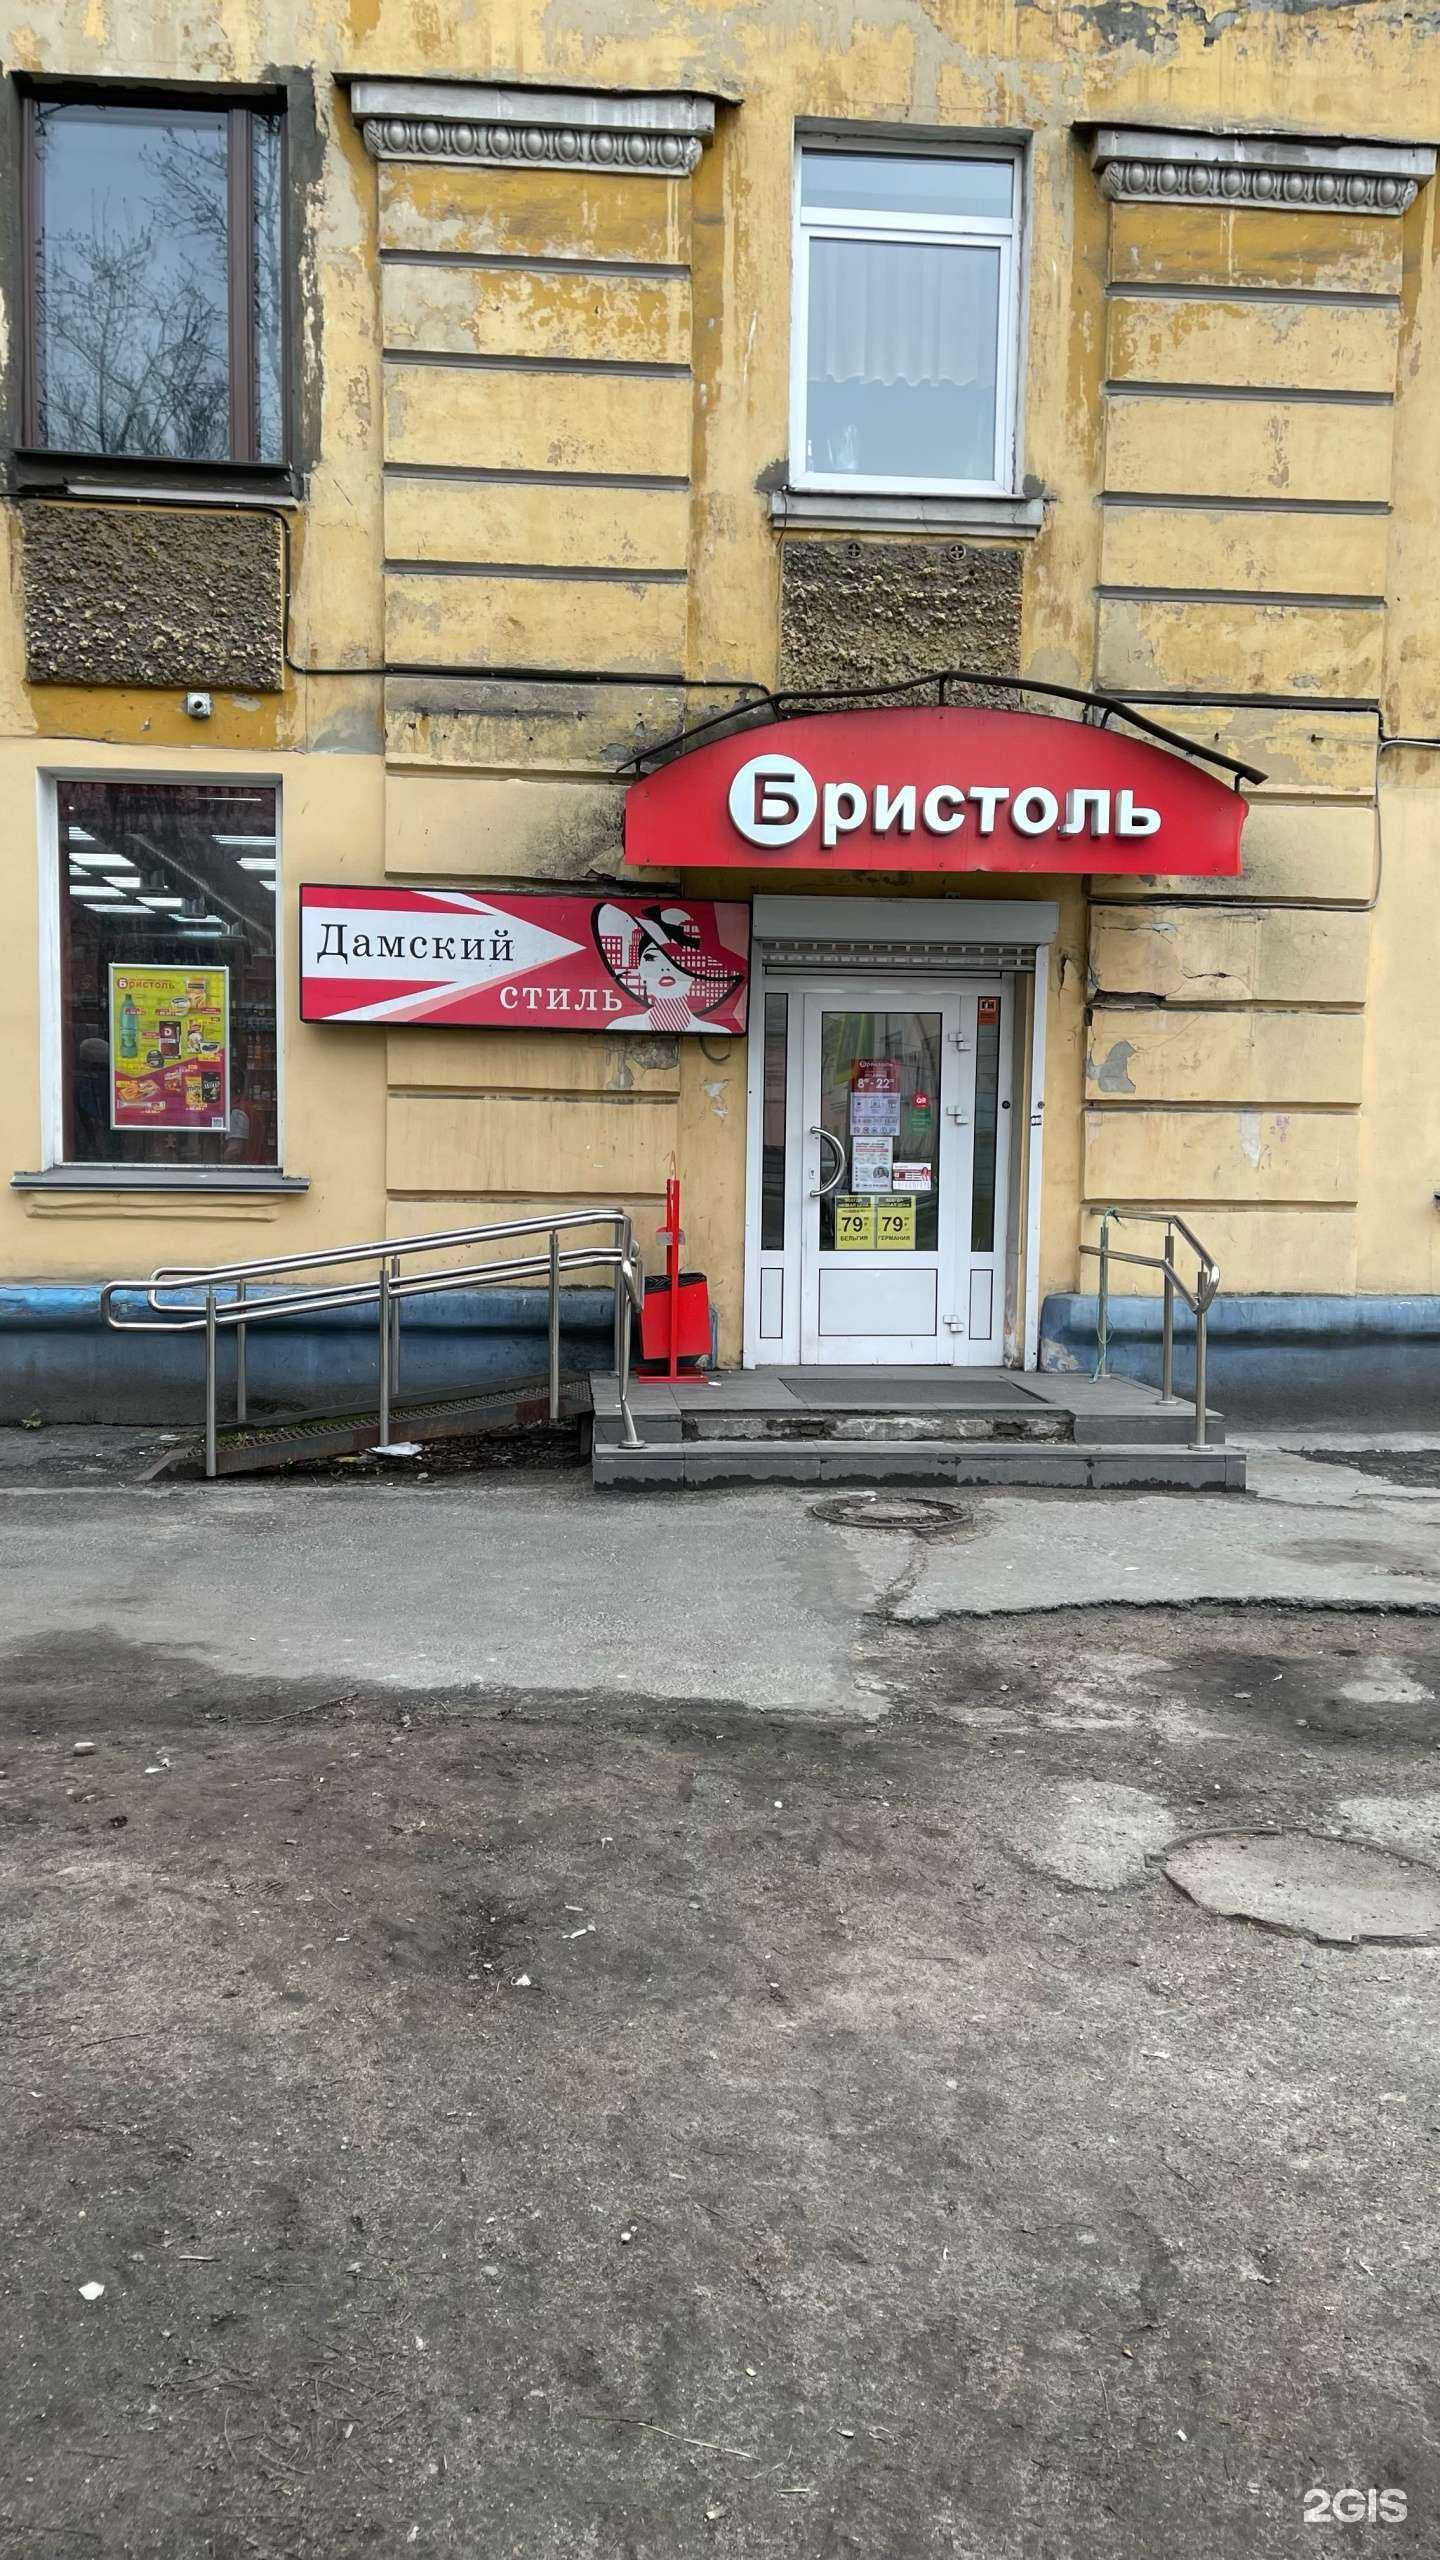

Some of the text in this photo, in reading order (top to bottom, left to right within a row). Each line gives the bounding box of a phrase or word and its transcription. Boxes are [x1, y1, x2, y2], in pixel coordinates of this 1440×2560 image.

[729, 754, 1161, 847] Бристоль
[316, 923, 515, 964] Дамский
[499, 985, 623, 1012] стиль
[841, 1216, 863, 1232] 79
[881, 1216, 903, 1232] 79
